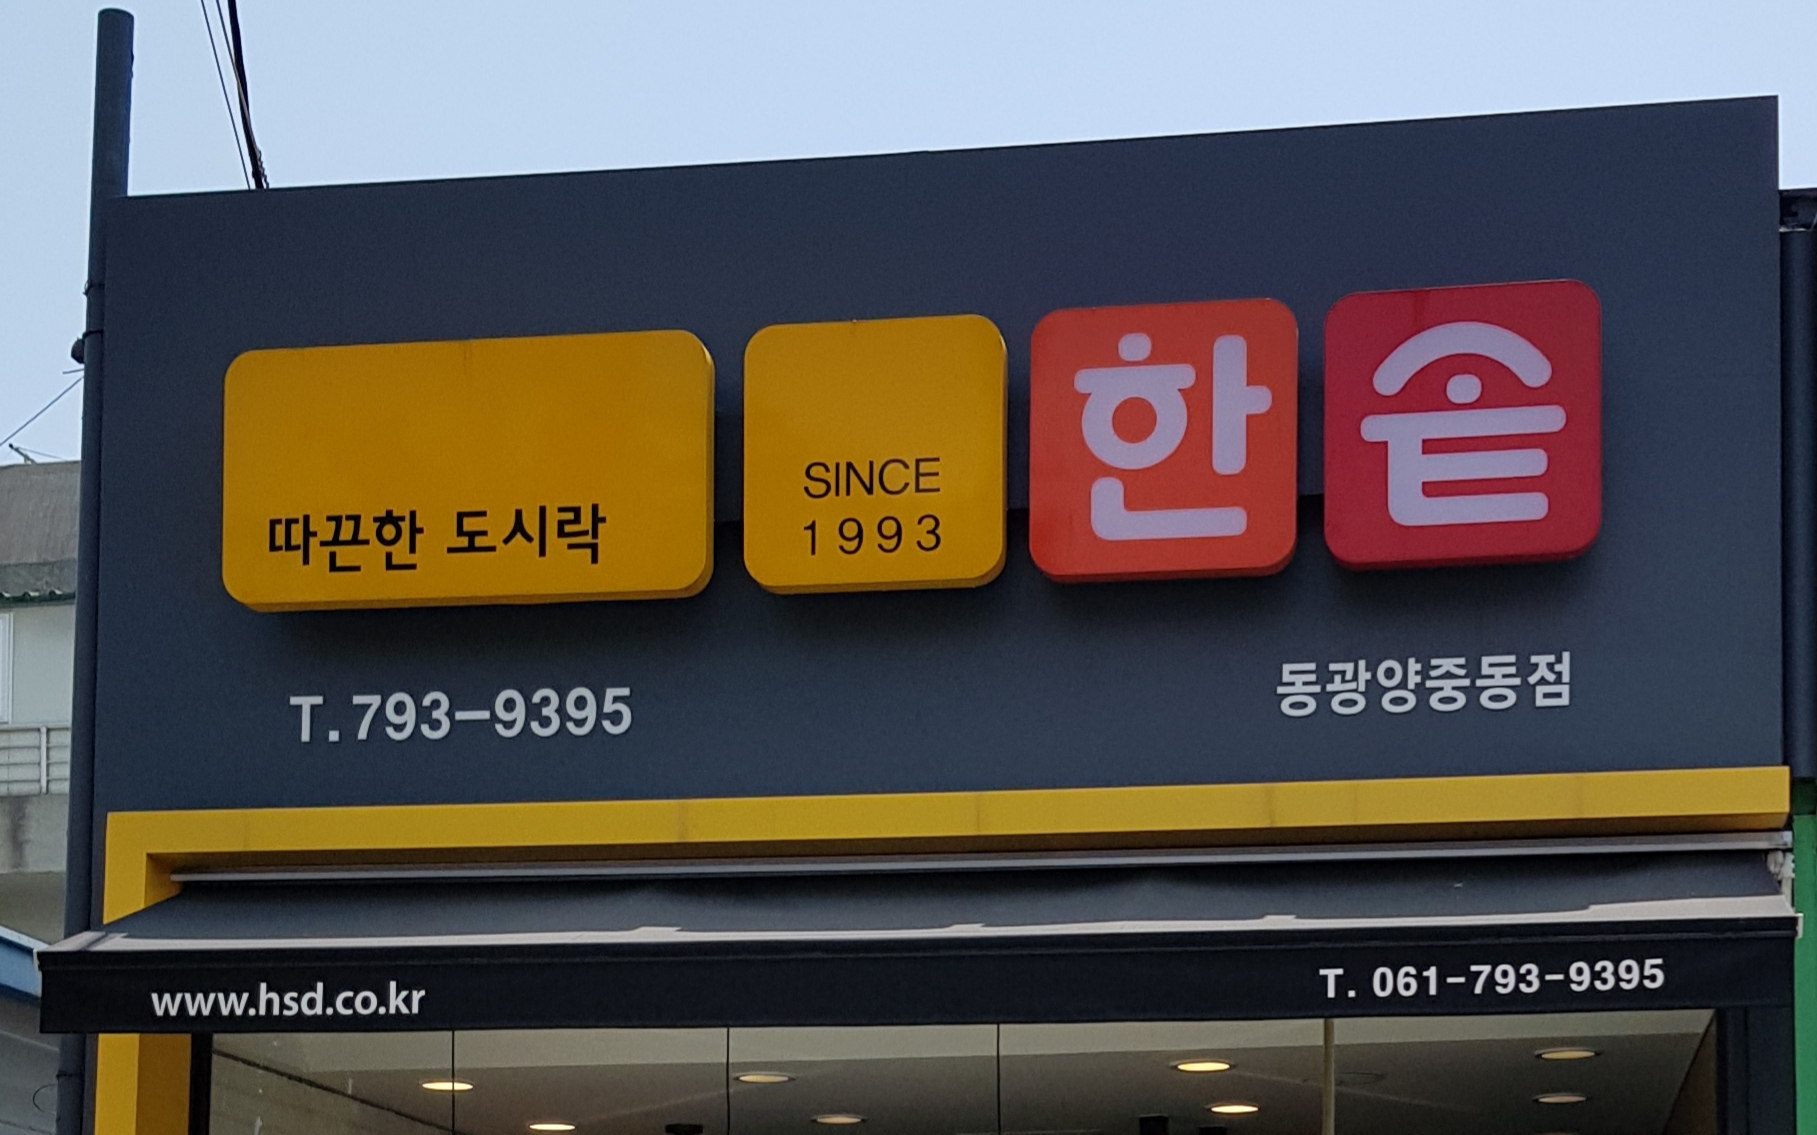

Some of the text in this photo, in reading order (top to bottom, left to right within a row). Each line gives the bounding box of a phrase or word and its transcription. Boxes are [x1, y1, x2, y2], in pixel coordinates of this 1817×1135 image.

[803, 458, 941, 498] SINCE
[268, 503, 607, 572] 따끈한 도시락
[803, 514, 941, 556] 1993
[1276, 651, 1572, 717] 동광양중동점
[1372, 958, 1665, 997] 061-793-9395
[151, 980, 426, 1017] www.hsd.co.kr
